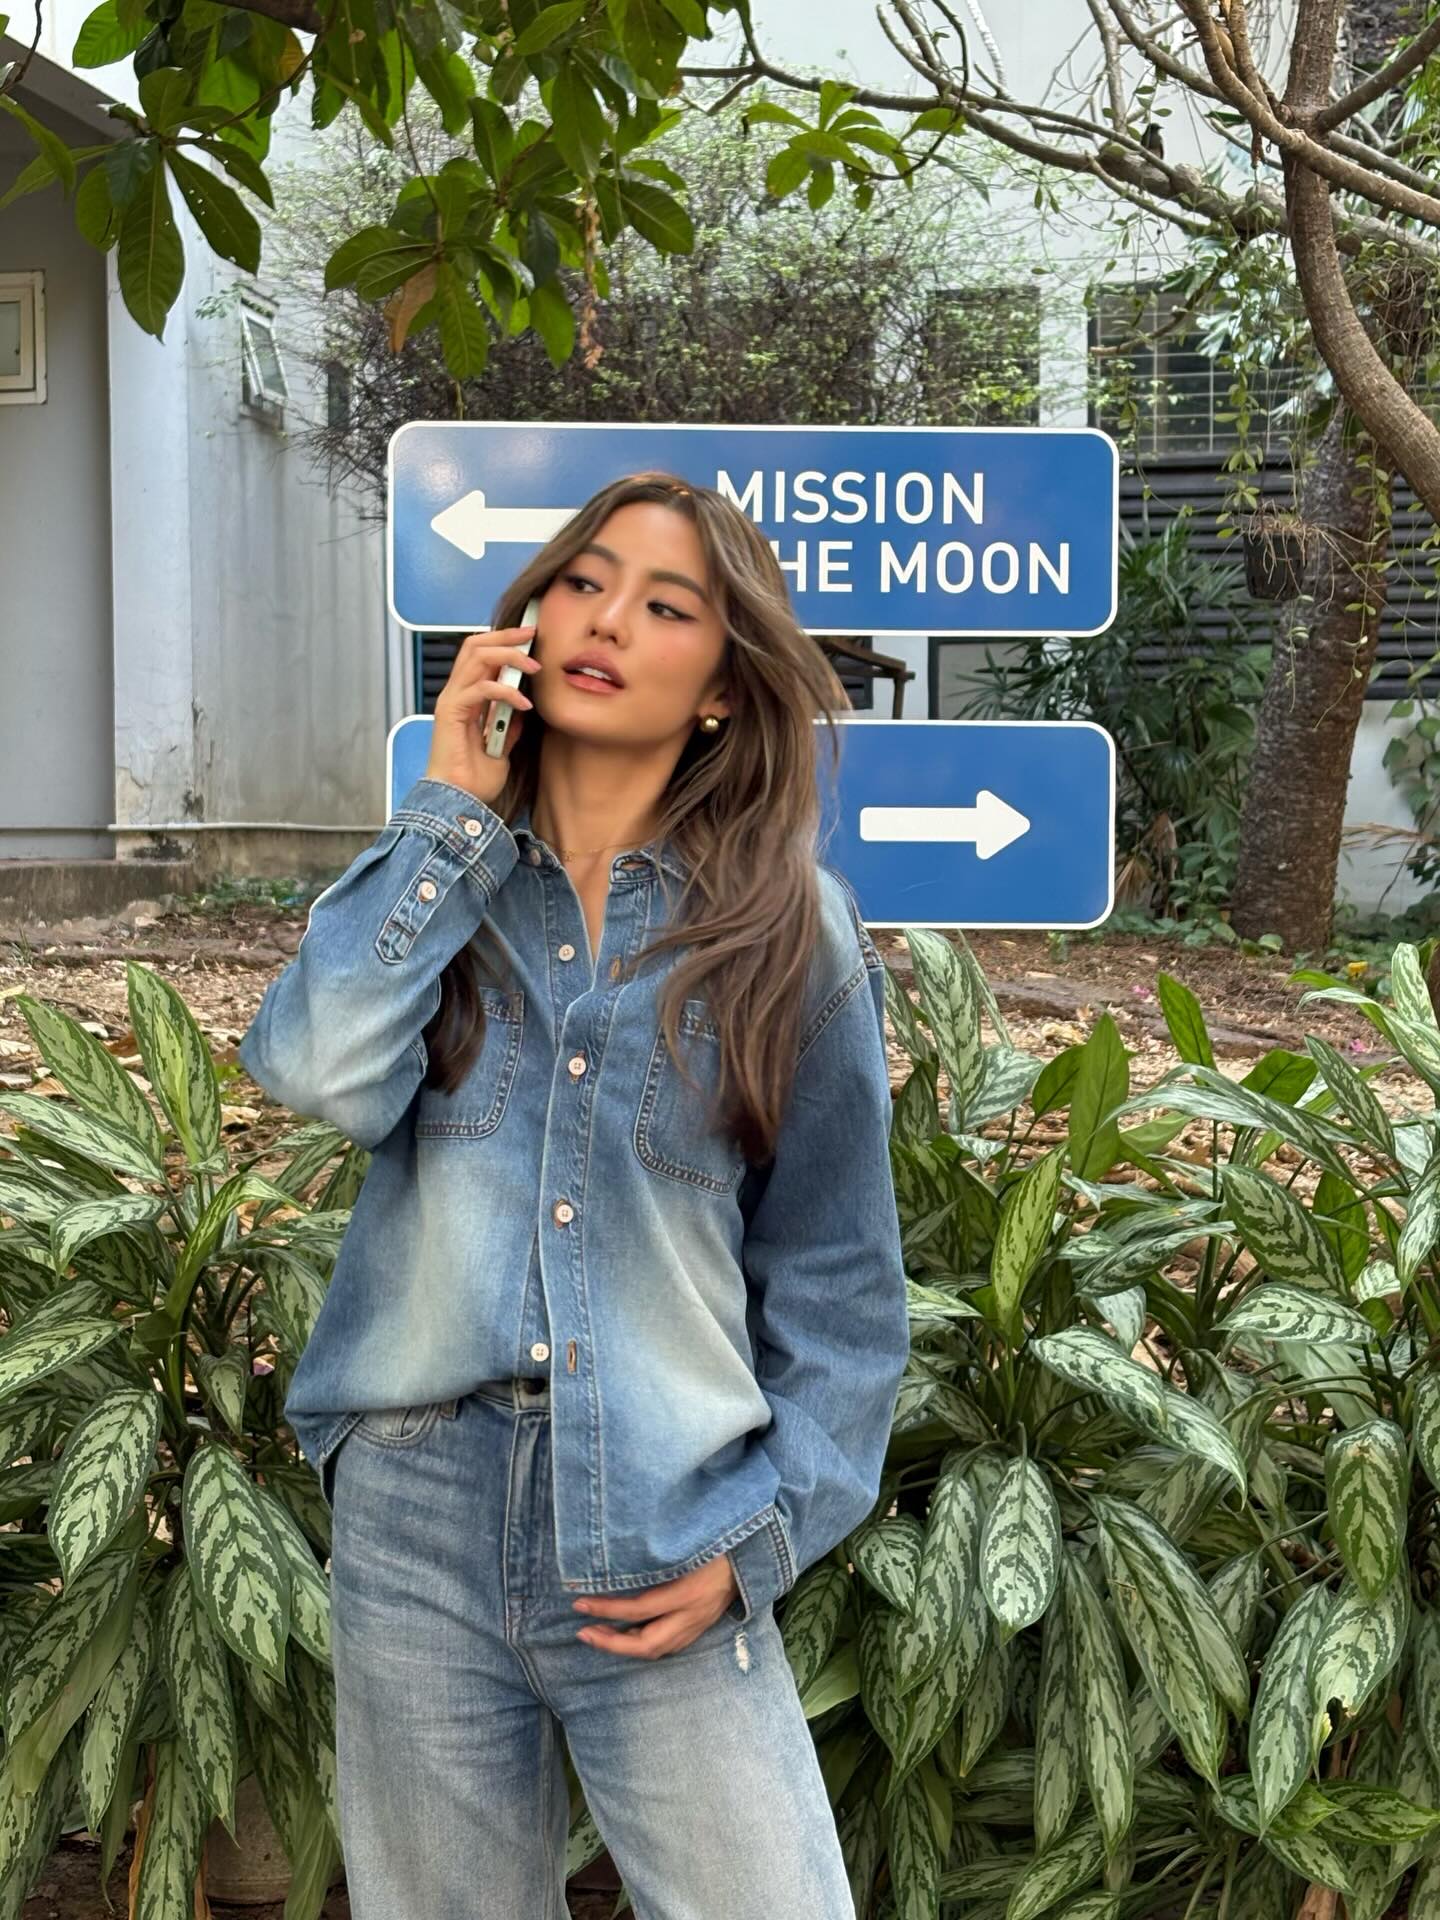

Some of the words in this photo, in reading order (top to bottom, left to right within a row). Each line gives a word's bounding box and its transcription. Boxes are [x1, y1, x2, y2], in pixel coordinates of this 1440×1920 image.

[717, 470, 984, 525] MISSION
[769, 540, 853, 593] HE
[880, 541, 1070, 595] MOON
